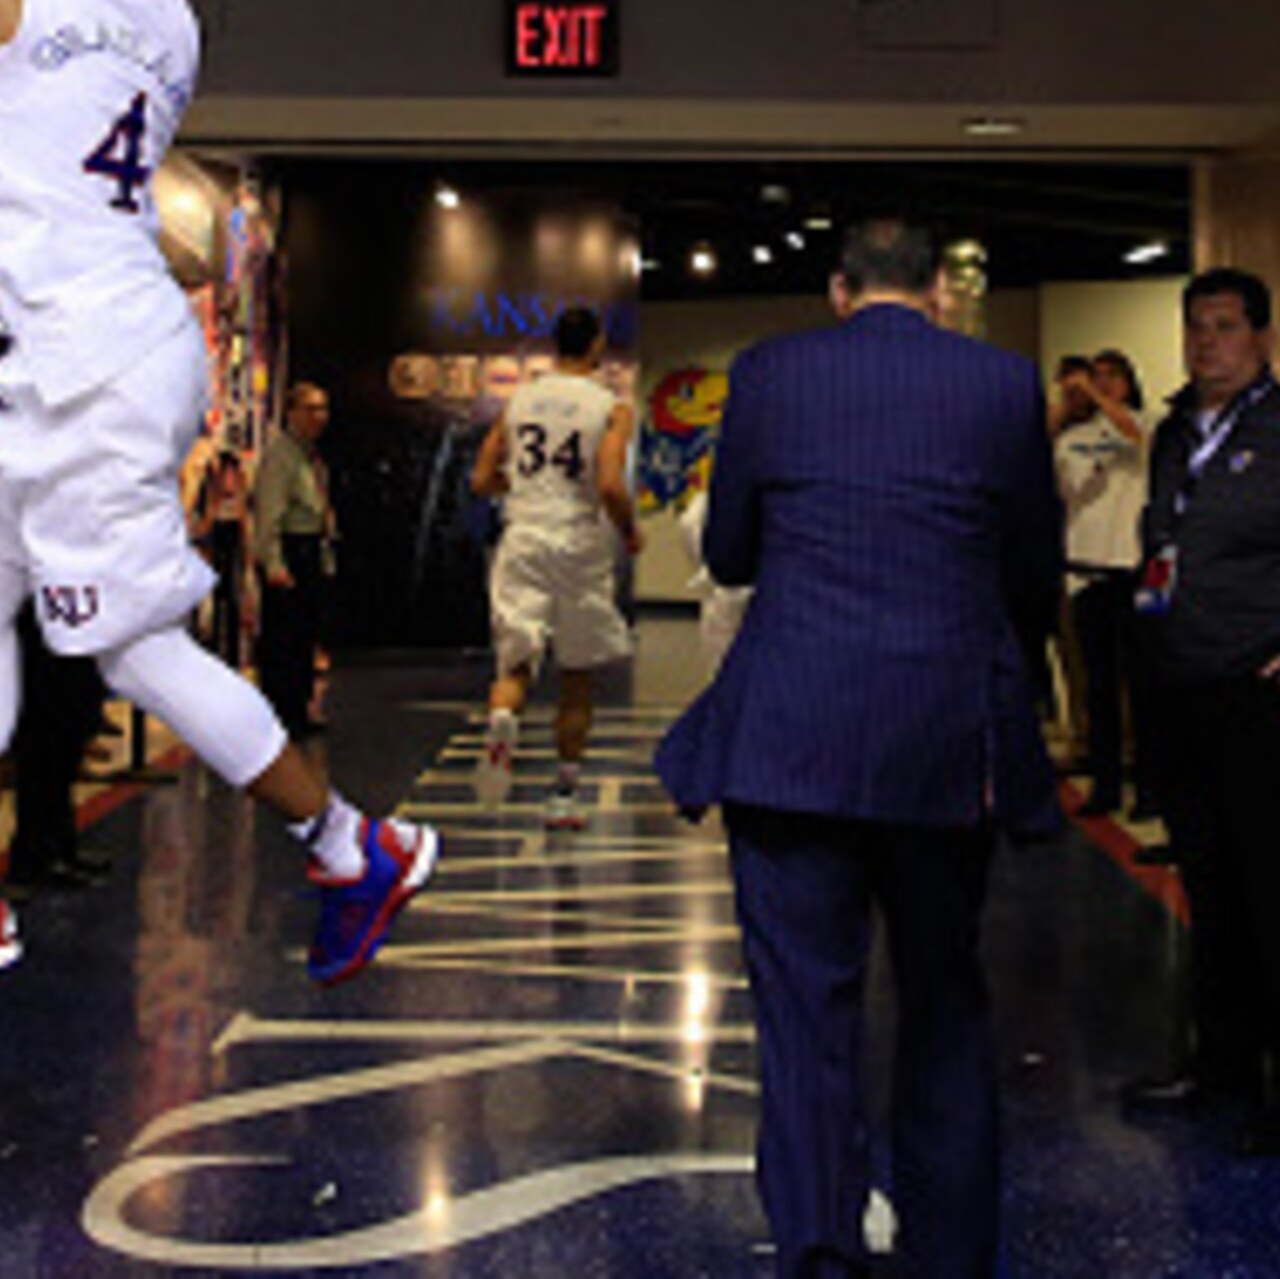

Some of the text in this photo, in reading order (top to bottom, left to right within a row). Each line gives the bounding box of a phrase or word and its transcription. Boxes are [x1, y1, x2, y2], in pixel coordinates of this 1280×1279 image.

[516, 2, 606, 67] EXIT
[83, 90, 151, 214] 4
[517, 423, 582, 480] 34
[42, 585, 98, 628] KU
